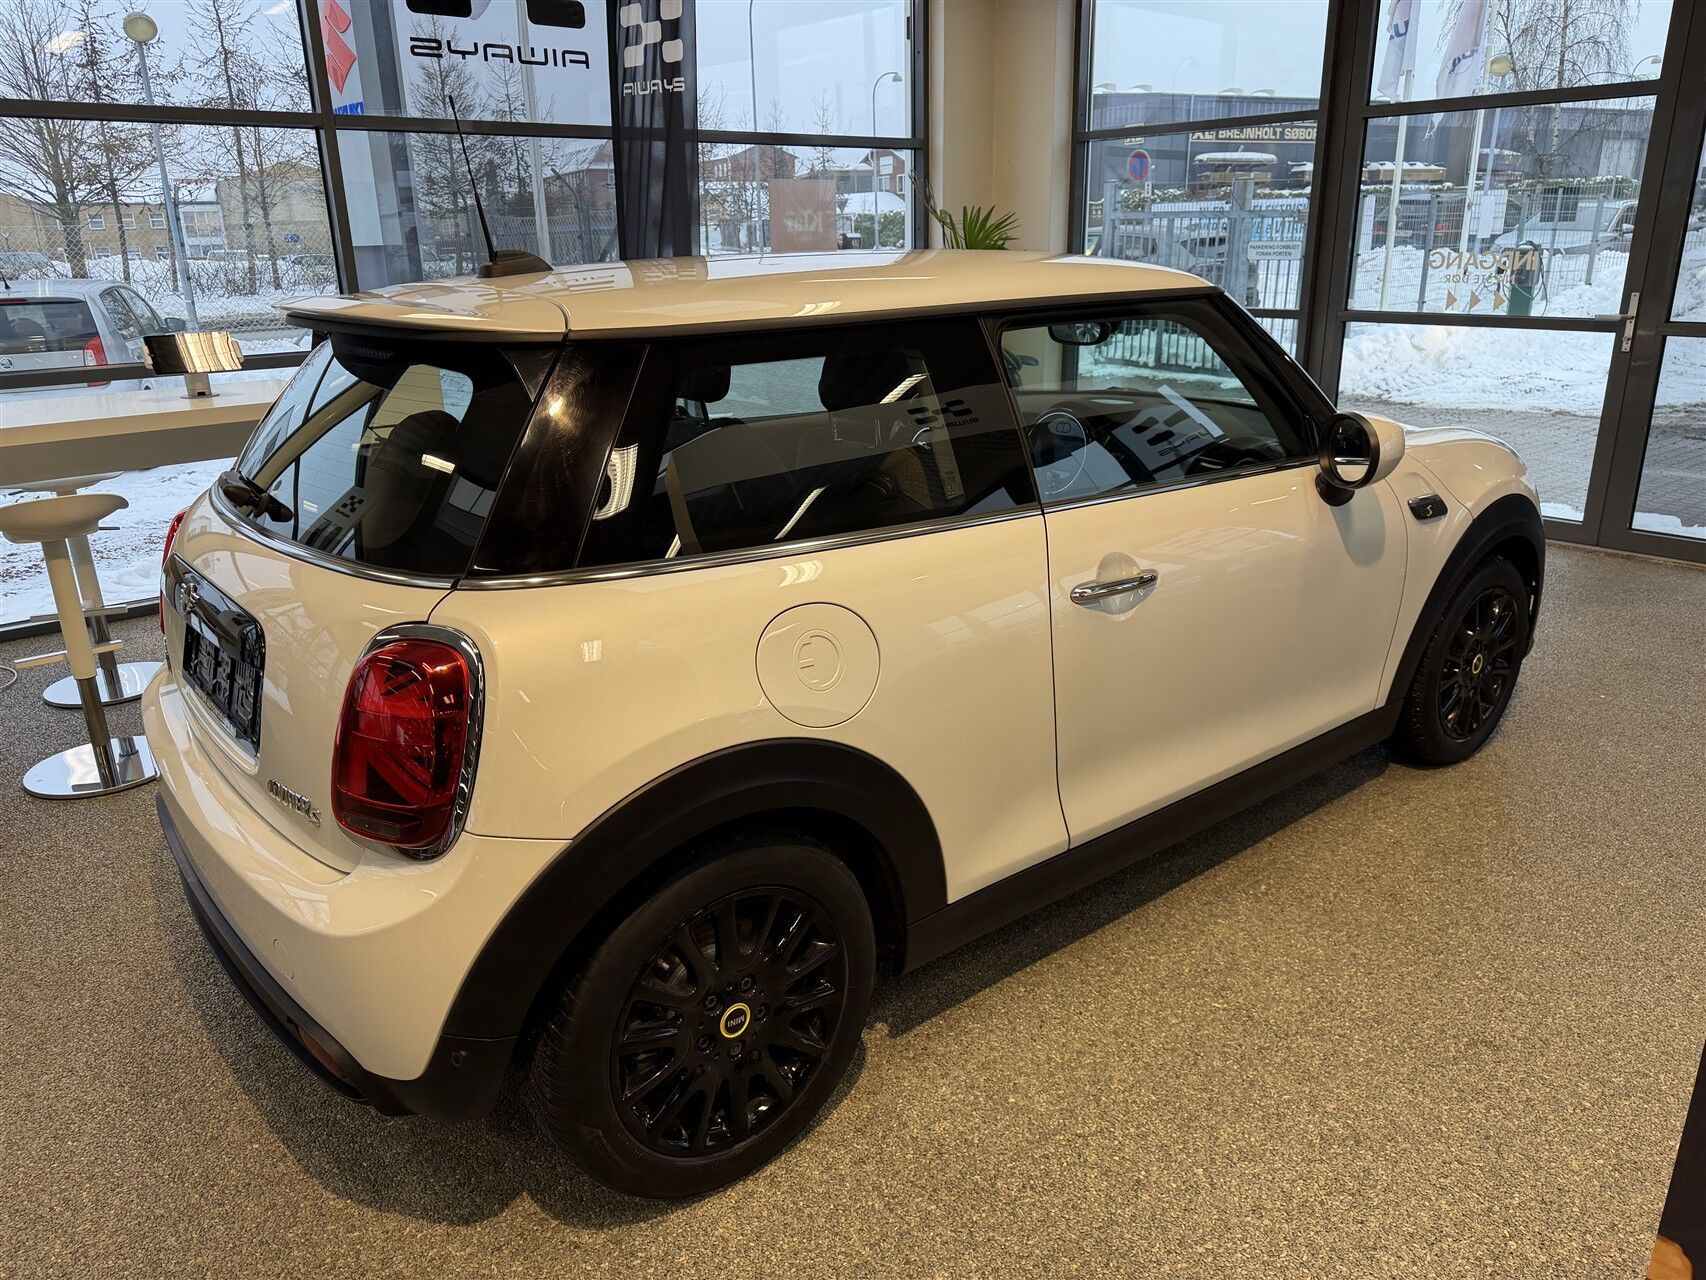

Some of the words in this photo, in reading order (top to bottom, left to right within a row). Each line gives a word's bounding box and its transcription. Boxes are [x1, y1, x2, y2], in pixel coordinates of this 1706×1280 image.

[623, 77, 685, 97] AIWAYS
[1217, 126, 1282, 140] BREJNHOLT
[727, 1014, 745, 1028] MINI
